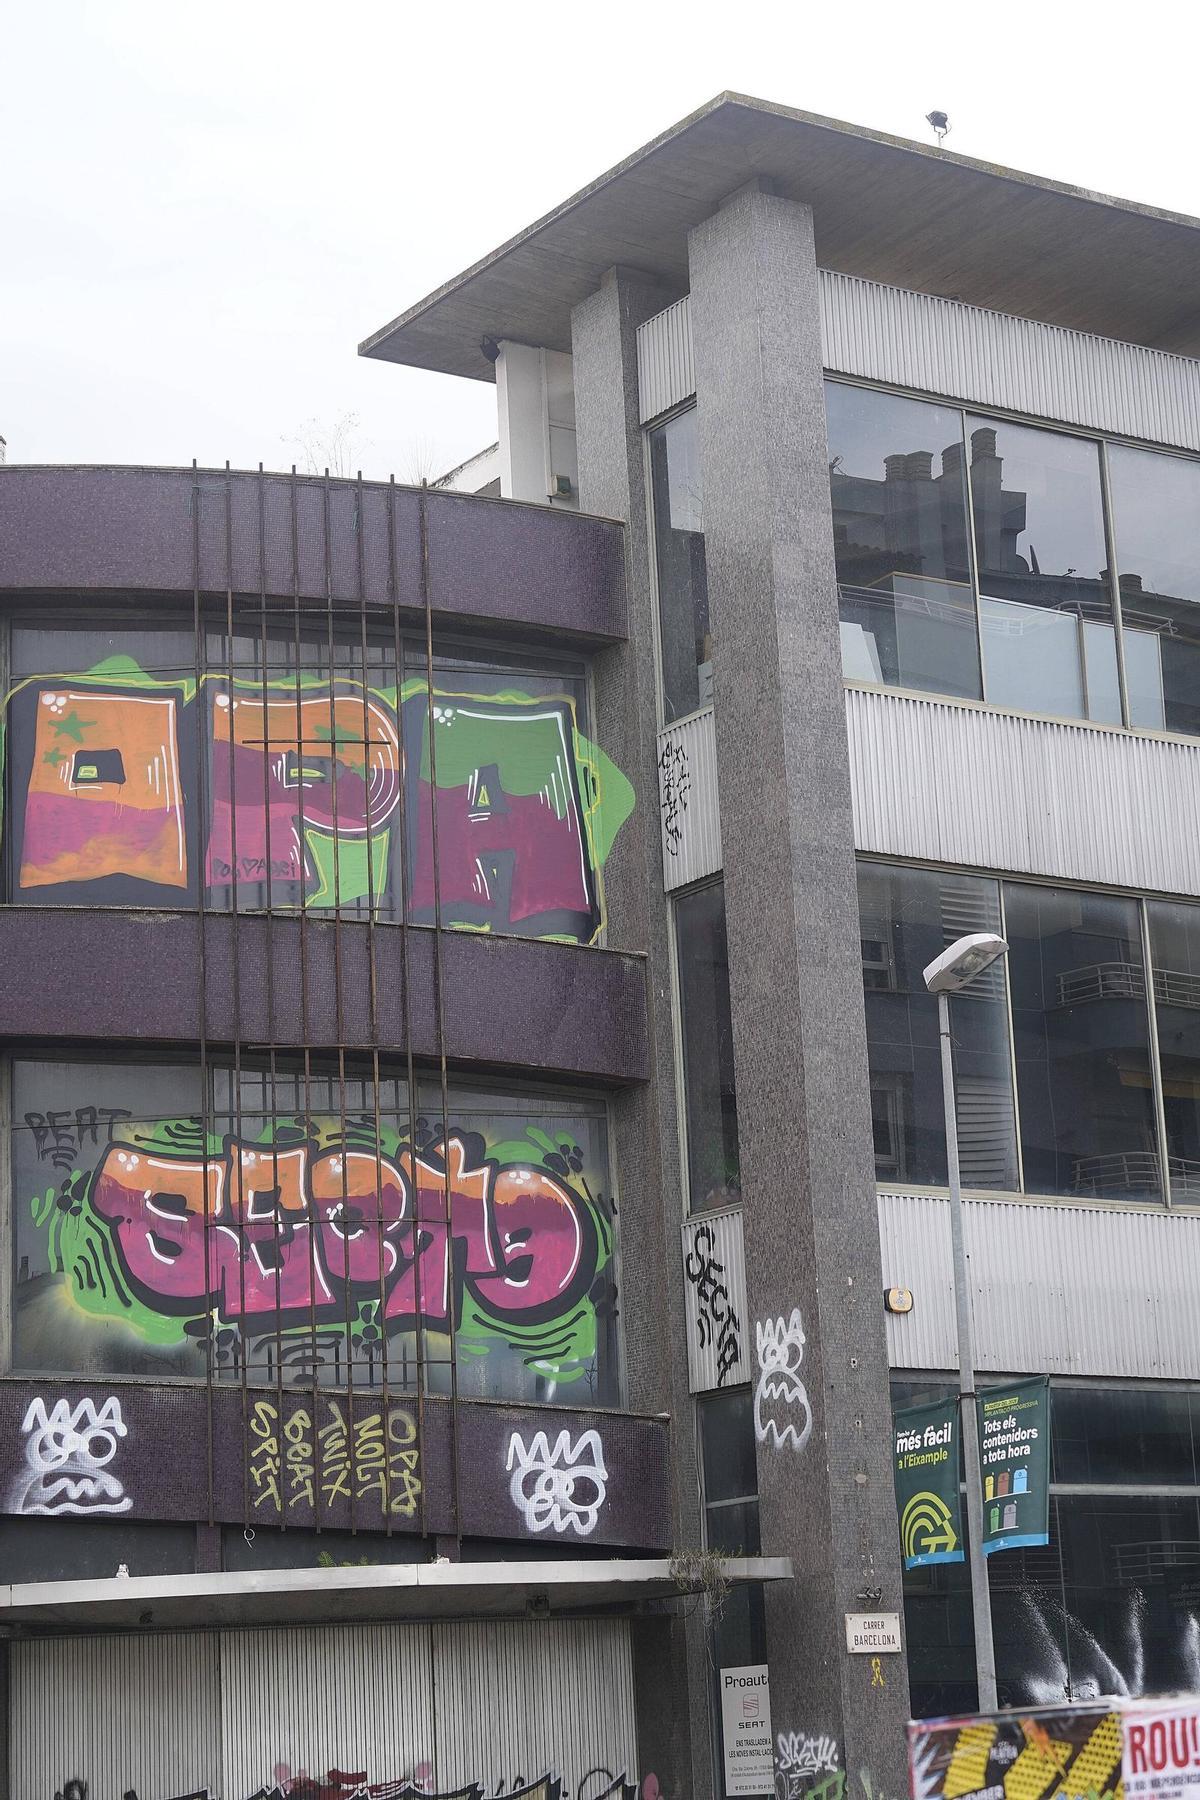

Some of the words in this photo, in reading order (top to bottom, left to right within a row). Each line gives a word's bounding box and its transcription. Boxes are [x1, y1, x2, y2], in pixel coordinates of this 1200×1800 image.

[983, 1420, 1001, 1434] Tots
[1003, 1415, 1016, 1429] els
[896, 1430, 921, 1453] més
[924, 1422, 952, 1447] fàcil
[983, 1427, 1038, 1449] contenidors
[983, 1454, 987, 1465] a
[988, 1448, 1006, 1463] tota
[1008, 1445, 1030, 1458] hora
[898, 1459, 903, 1469] a
[863, 1621, 885, 1630] CARRER
[854, 1634, 896, 1646] BARCELONA
[725, 1674, 768, 1688] Proaut
[738, 1720, 765, 1729] SEAT
